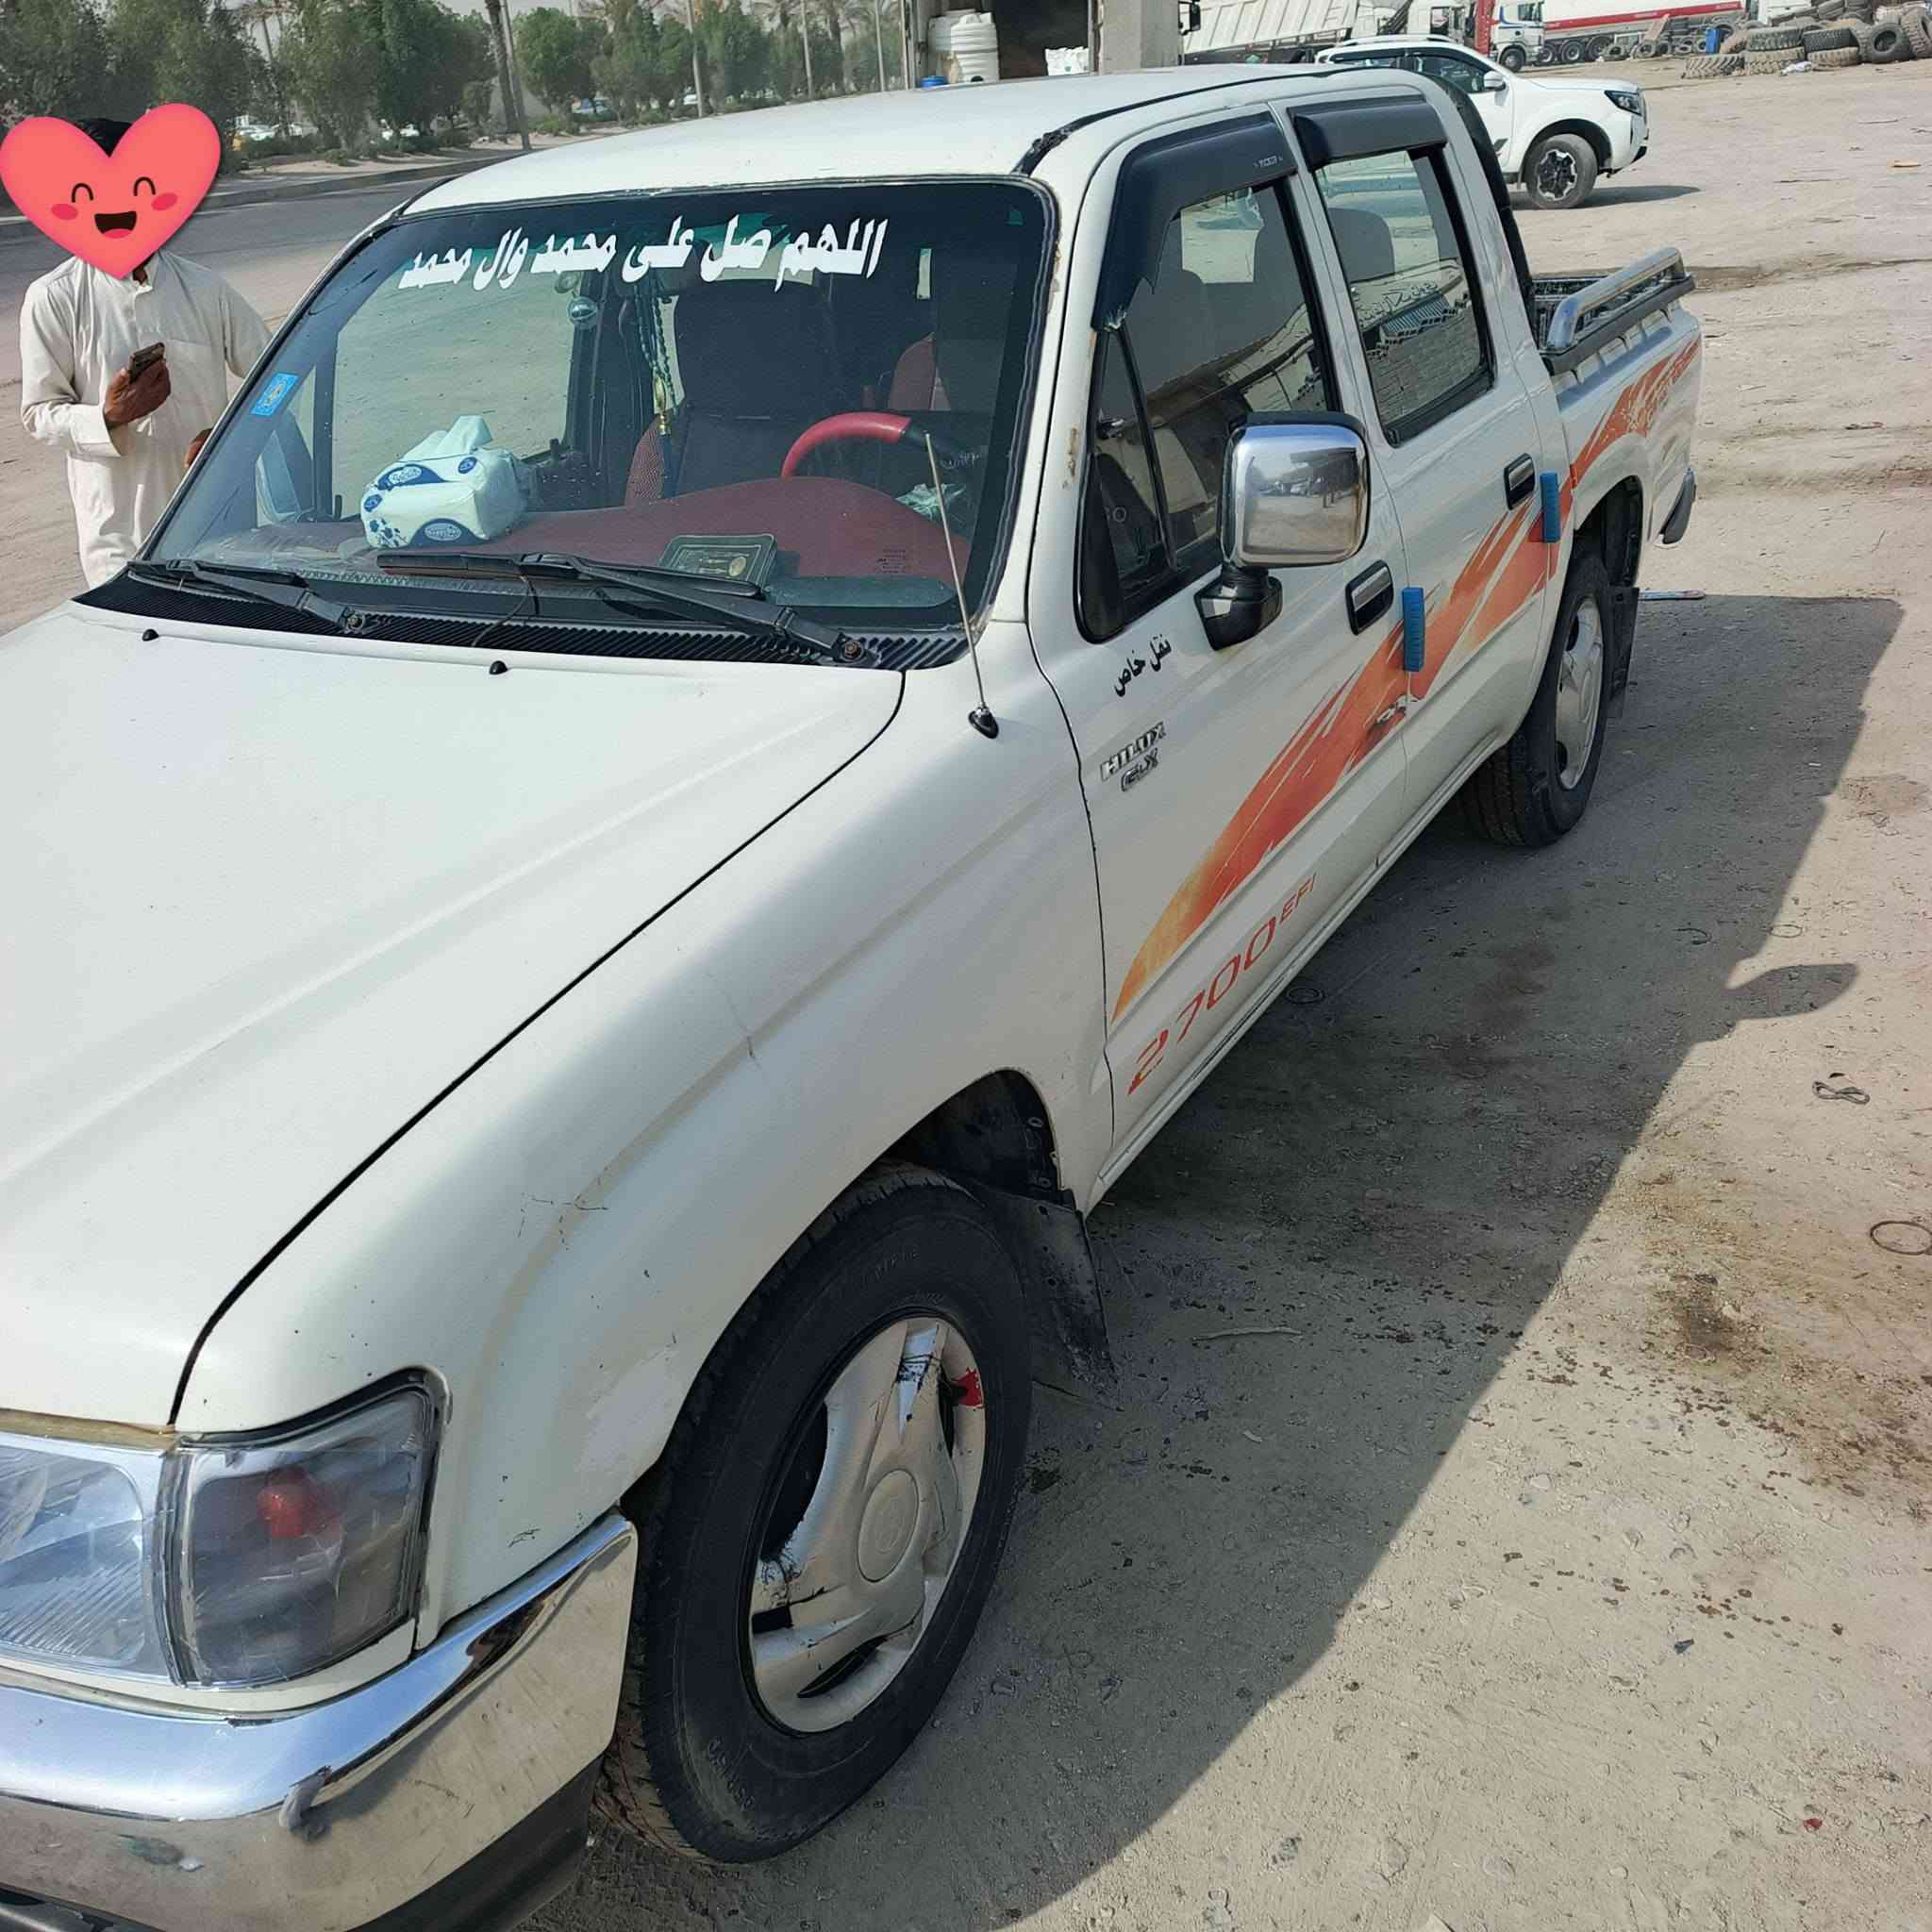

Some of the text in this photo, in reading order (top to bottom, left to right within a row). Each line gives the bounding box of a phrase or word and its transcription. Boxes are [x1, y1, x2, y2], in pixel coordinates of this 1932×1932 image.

[397, 247, 474, 290] محمد
[530, 233, 617, 273] محمد
[622, 215, 695, 283] على
[700, 214, 772, 283] صل
[774, 218, 888, 292] اللهم
[1114, 634, 1172, 697] نقل خاص
[1100, 722, 1166, 782] HILUX
[1127, 916, 1276, 1095] 2700
